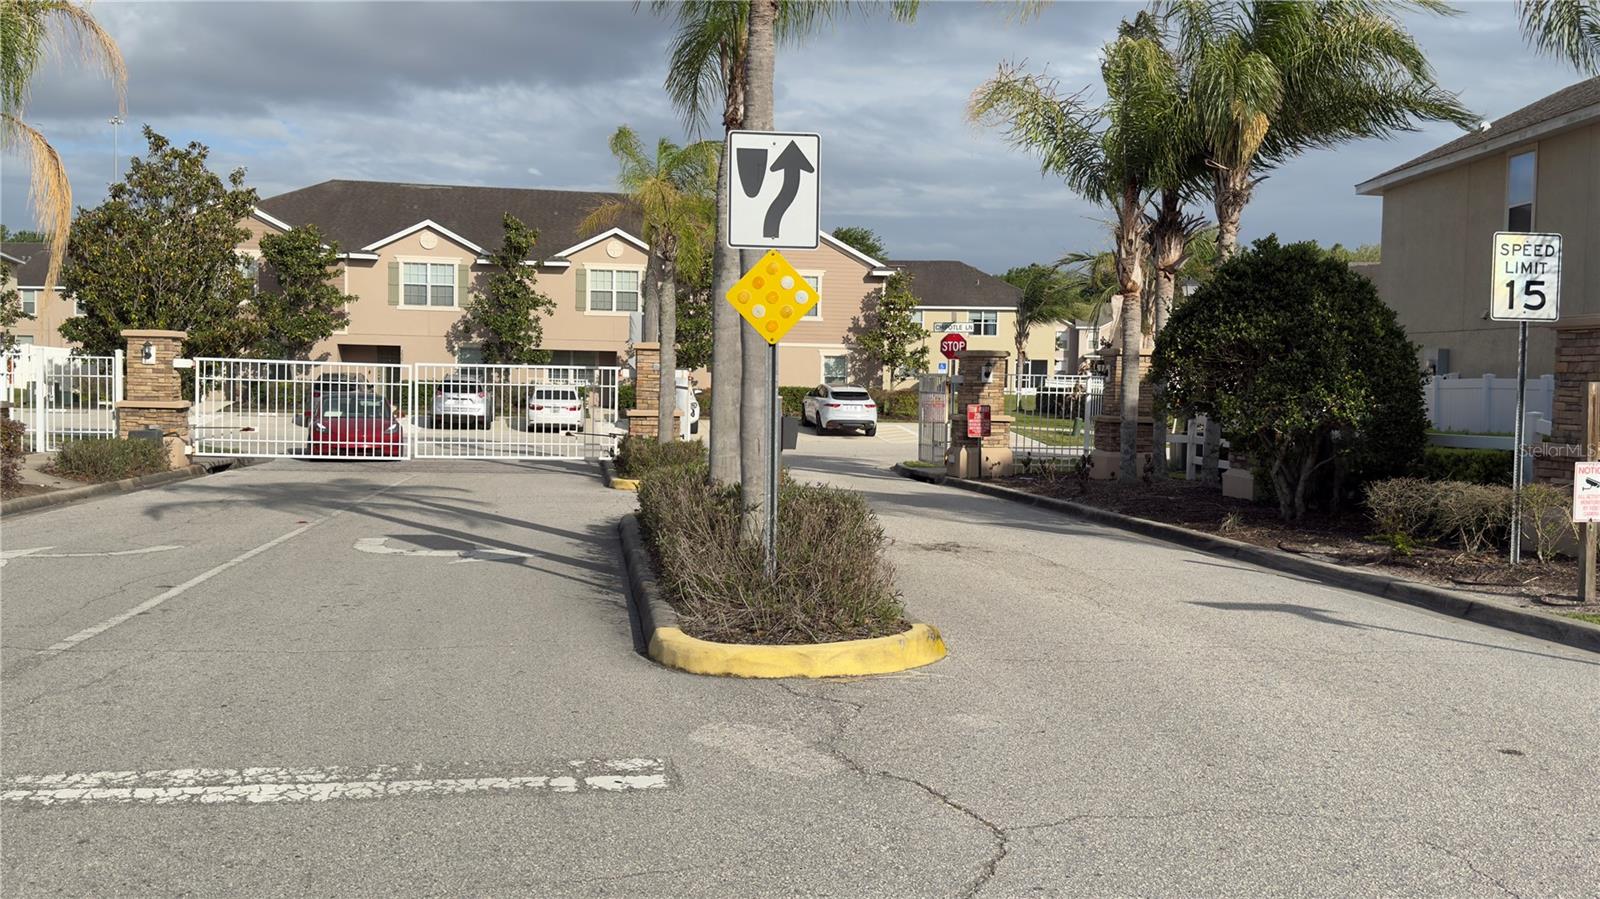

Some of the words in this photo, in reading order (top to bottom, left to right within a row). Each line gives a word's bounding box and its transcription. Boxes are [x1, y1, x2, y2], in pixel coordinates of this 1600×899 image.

[1500, 243, 1555, 257] SPEED
[1505, 261, 1547, 274] LIMIT
[1506, 280, 1546, 310] 15
[942, 341, 965, 351] STOP
